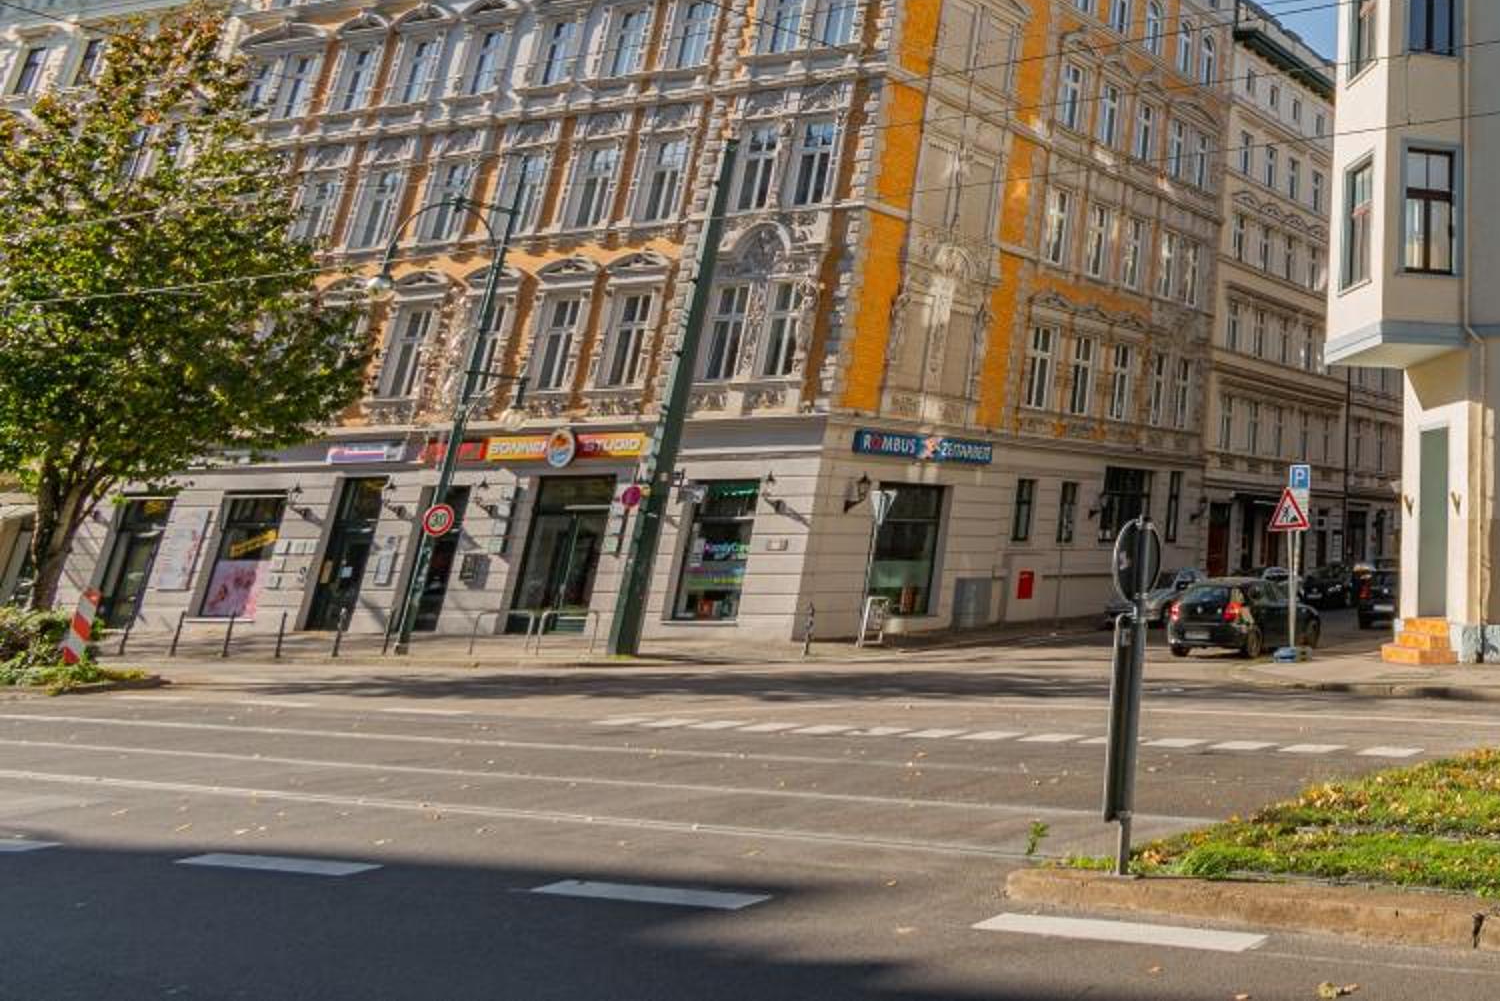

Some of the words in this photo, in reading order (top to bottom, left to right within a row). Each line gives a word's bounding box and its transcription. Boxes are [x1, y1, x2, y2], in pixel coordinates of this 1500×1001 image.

[583, 438, 641, 452] STUDIO
[863, 433, 917, 454] ROMBUS
[1295, 468, 1305, 487] P
[428, 512, 447, 529] 30
